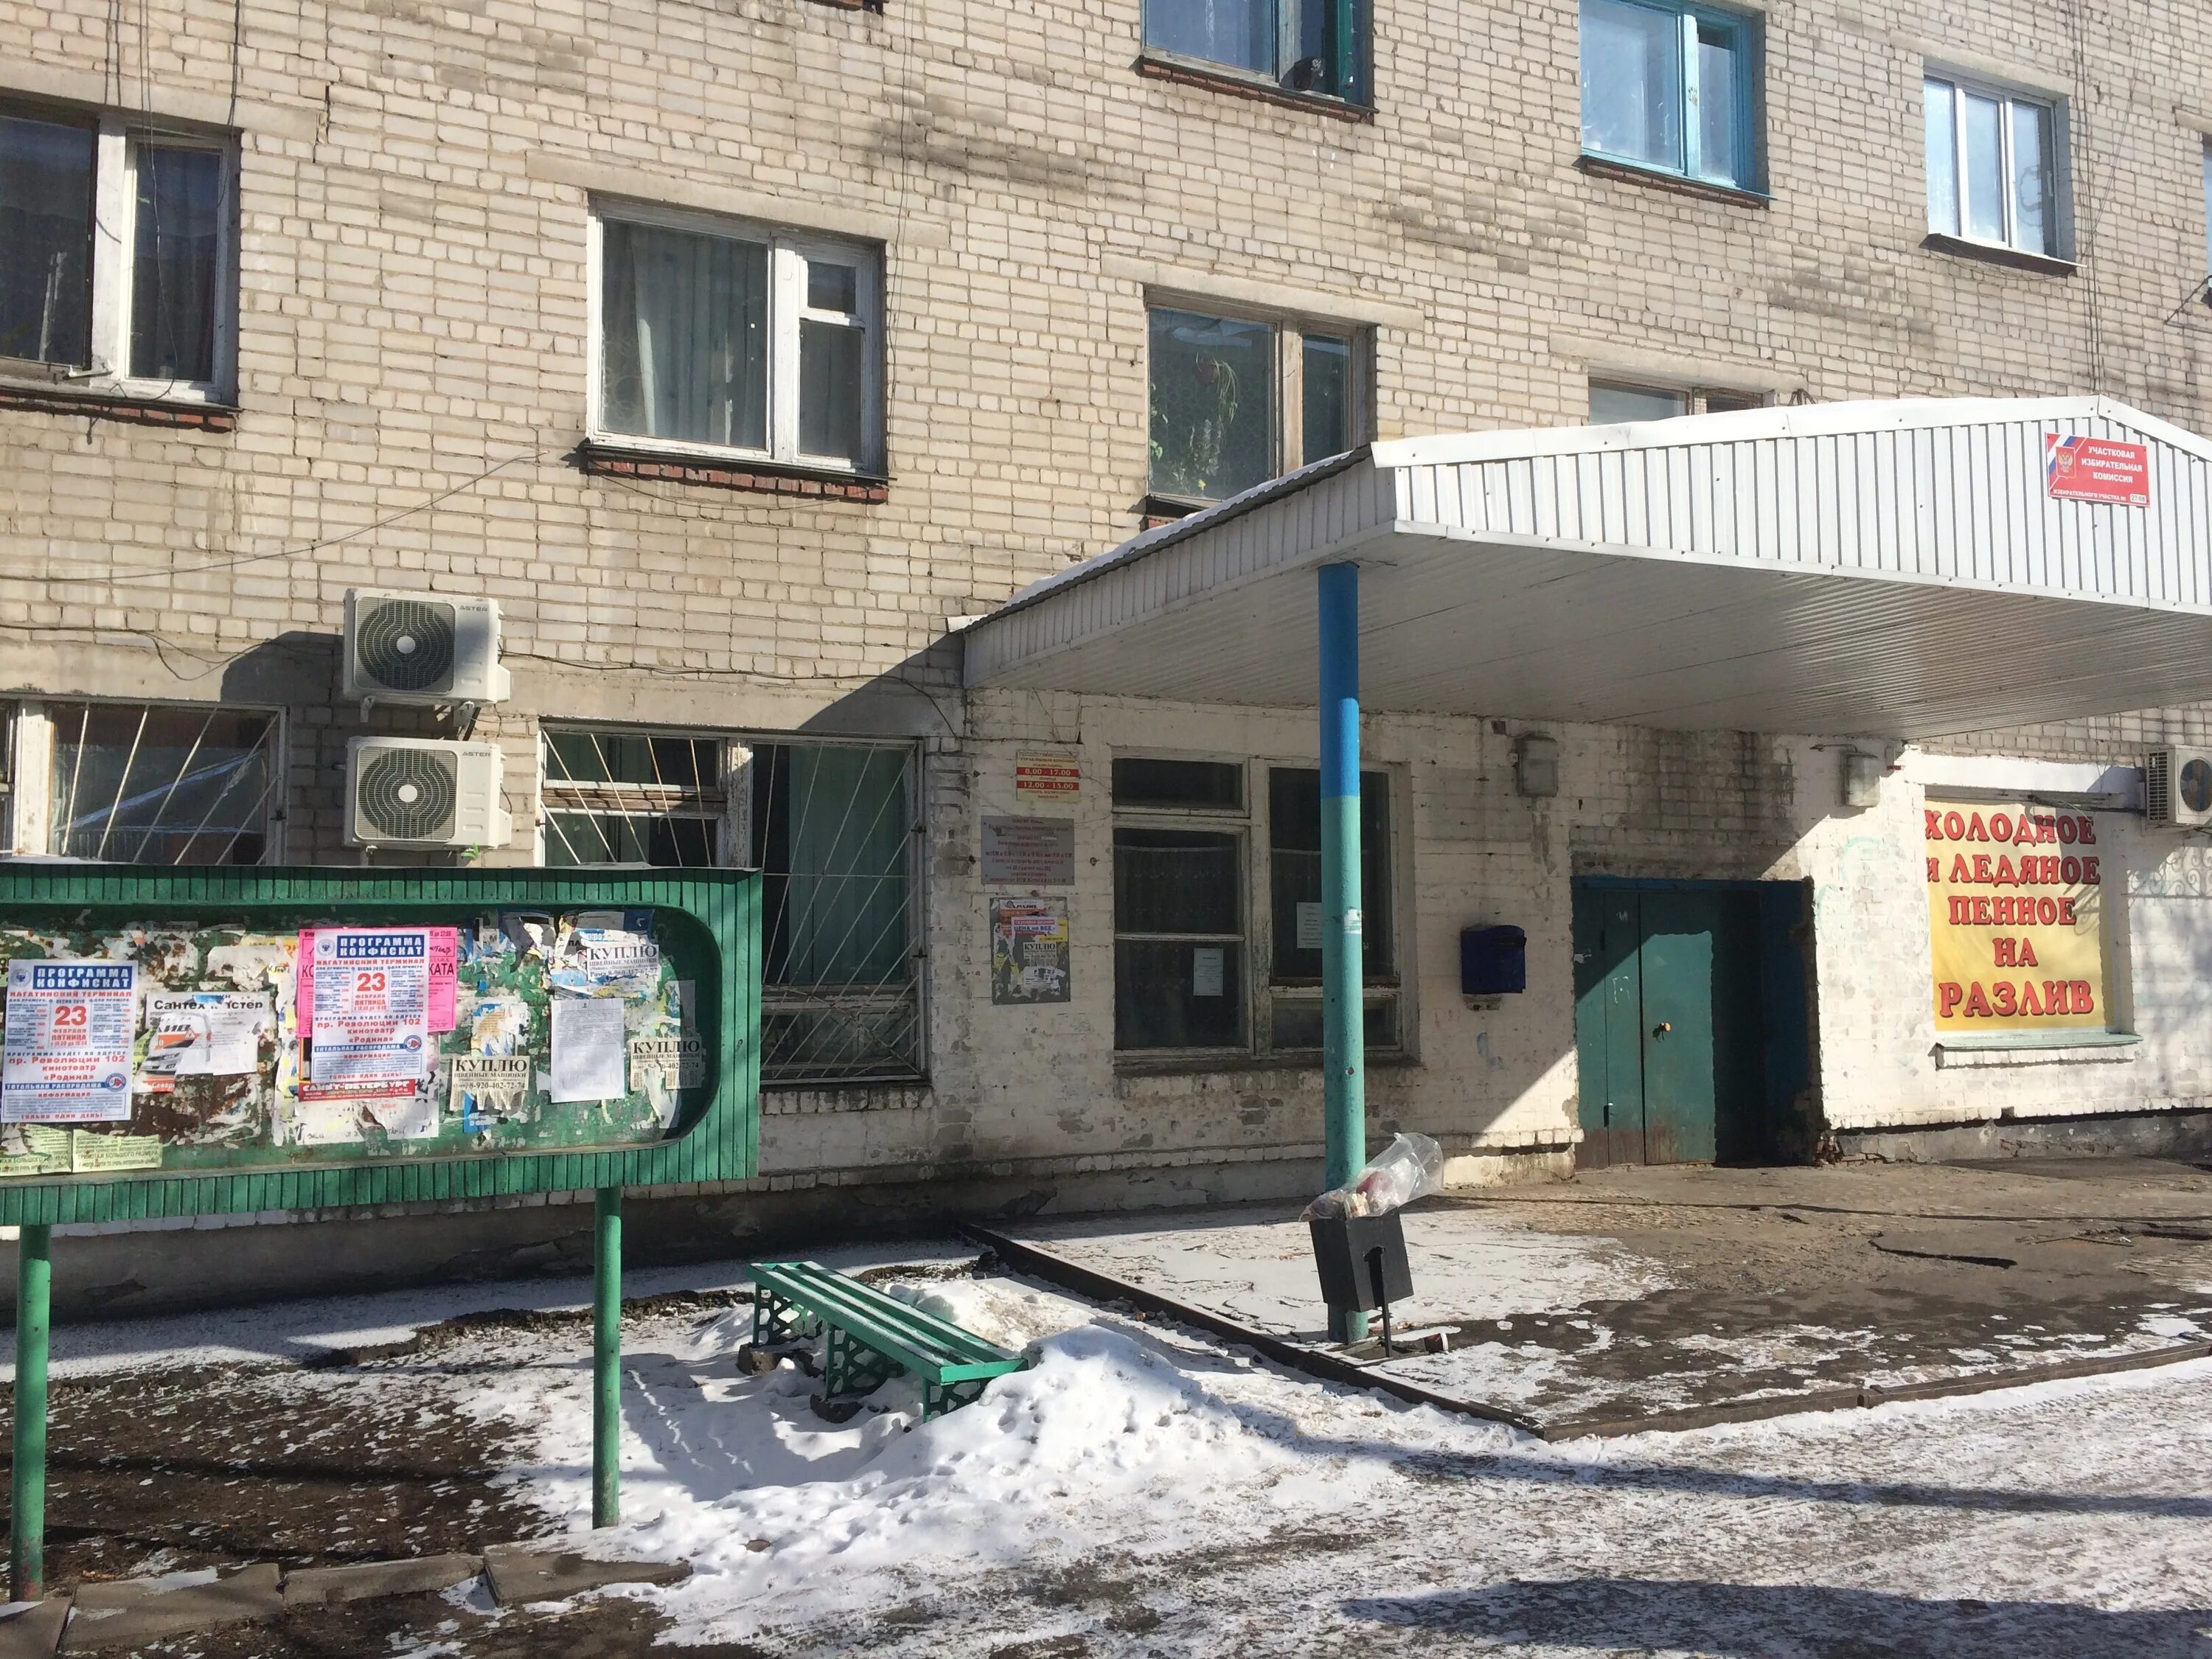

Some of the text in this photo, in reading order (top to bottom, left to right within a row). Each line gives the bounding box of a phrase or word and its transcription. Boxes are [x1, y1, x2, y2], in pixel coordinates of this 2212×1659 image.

[2088, 446, 2135, 459] УЧАСТКОВАЯ
[2081, 458, 2142, 472] ИЗБИРАТЕЛЬНАЯ
[2093, 472, 2133, 483] КОМИССИЯ
[2053, 489, 2098, 498] ИЗБИРАТЕЛЬНОГО
[2098, 493, 2120, 501] УЧАСТКА
[1925, 810, 2096, 846] ХОЛОДНОЕ
[1949, 853, 2101, 888] ЛЕДЯНОЕ
[1947, 896, 2077, 926] ПЕННОЕ
[340, 937, 422, 946] ПРОГРАММА
[340, 947, 422, 956] КОНФИСКАТ
[591, 946, 657, 959] КУПЛЮ
[1992, 937, 2039, 967] НА
[38, 968, 129, 978] ПРОГРАММА
[37, 978, 129, 988] КОНФИСКАТ
[357, 973, 386, 991] 23
[154, 1001, 205, 1009] Сантех
[1938, 980, 2094, 1018] РАЗЛИВ
[55, 1006, 87, 1026] 23
[634, 1040, 699, 1054] КУПЛЮ
[456, 1060, 527, 1071] КУПЛЮ
